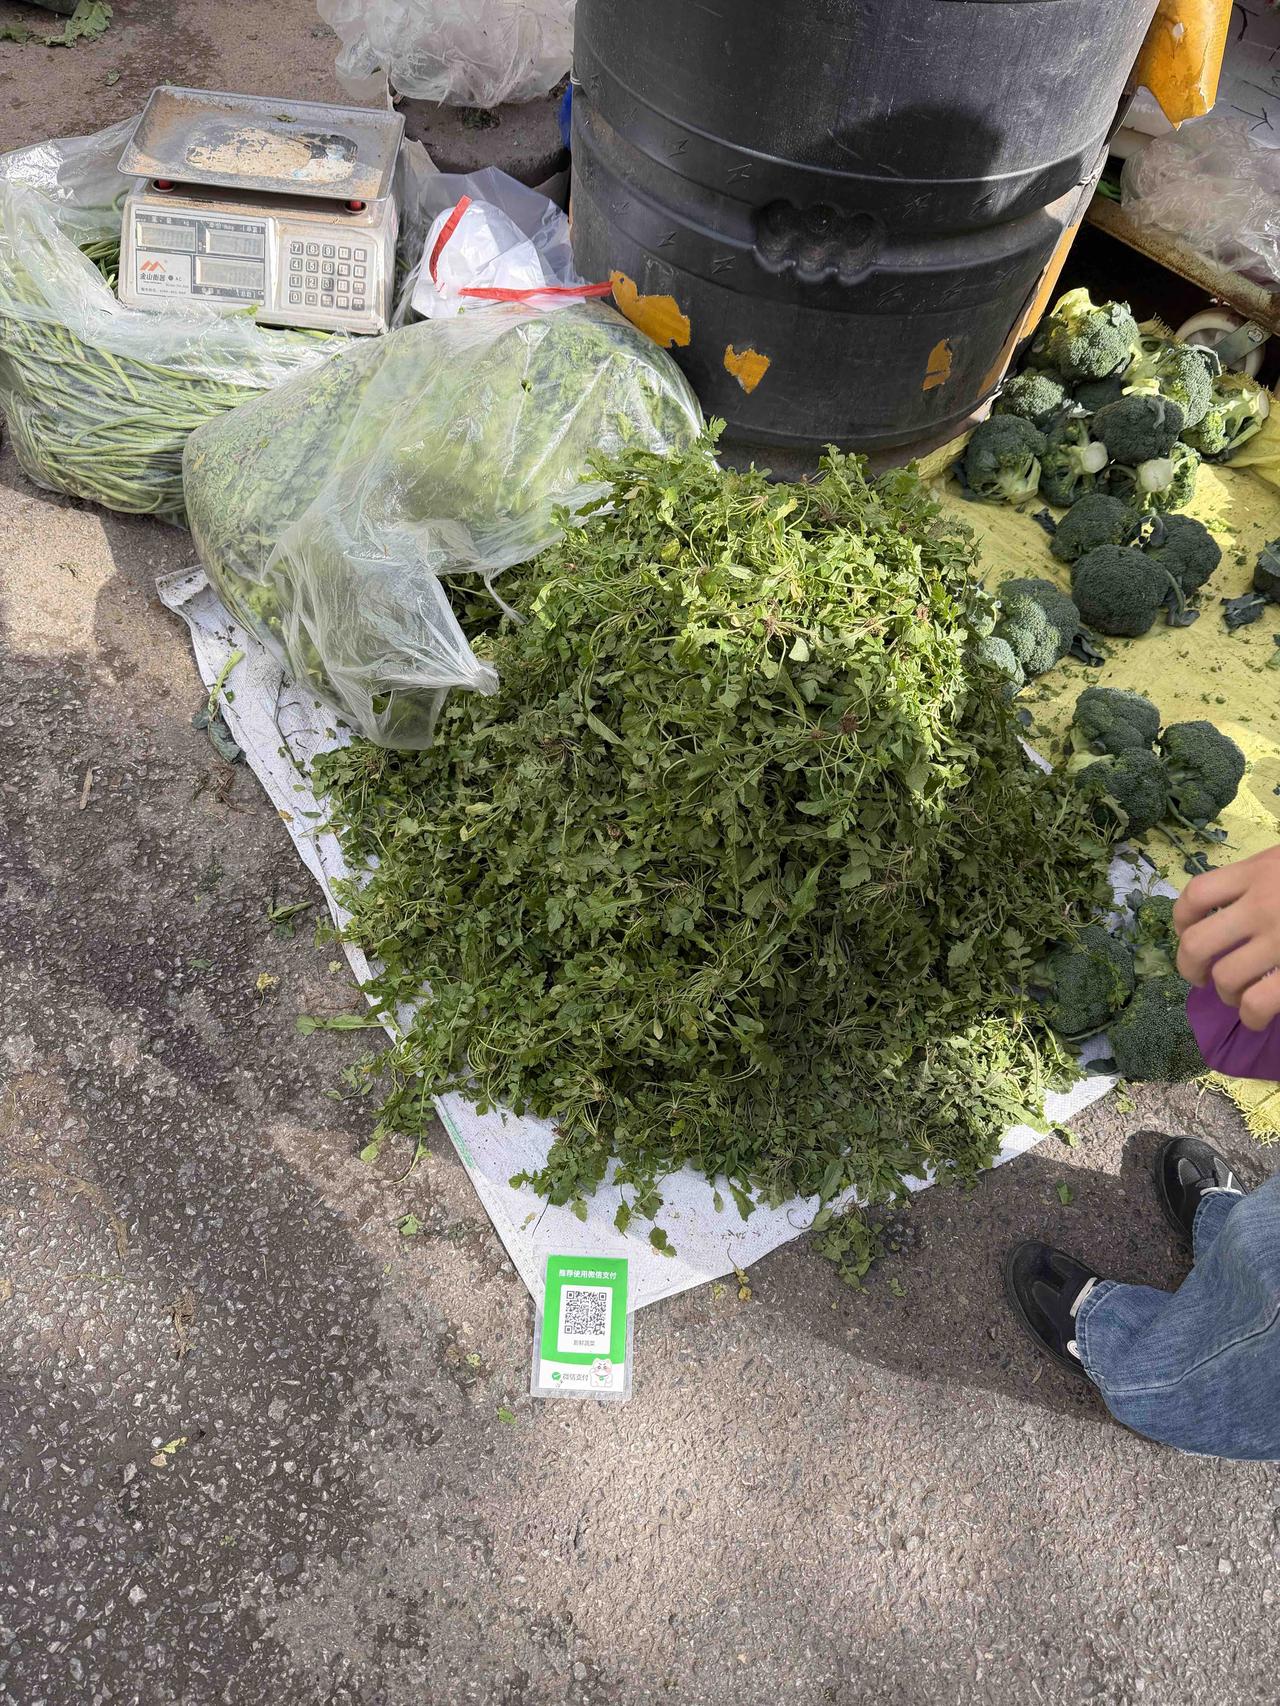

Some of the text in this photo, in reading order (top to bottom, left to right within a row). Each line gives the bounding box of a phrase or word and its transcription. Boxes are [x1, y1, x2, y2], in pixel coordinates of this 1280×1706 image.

[559, 1269, 617, 1280] 推荐使用微信支付
[562, 1373, 589, 1382] 微信支付
